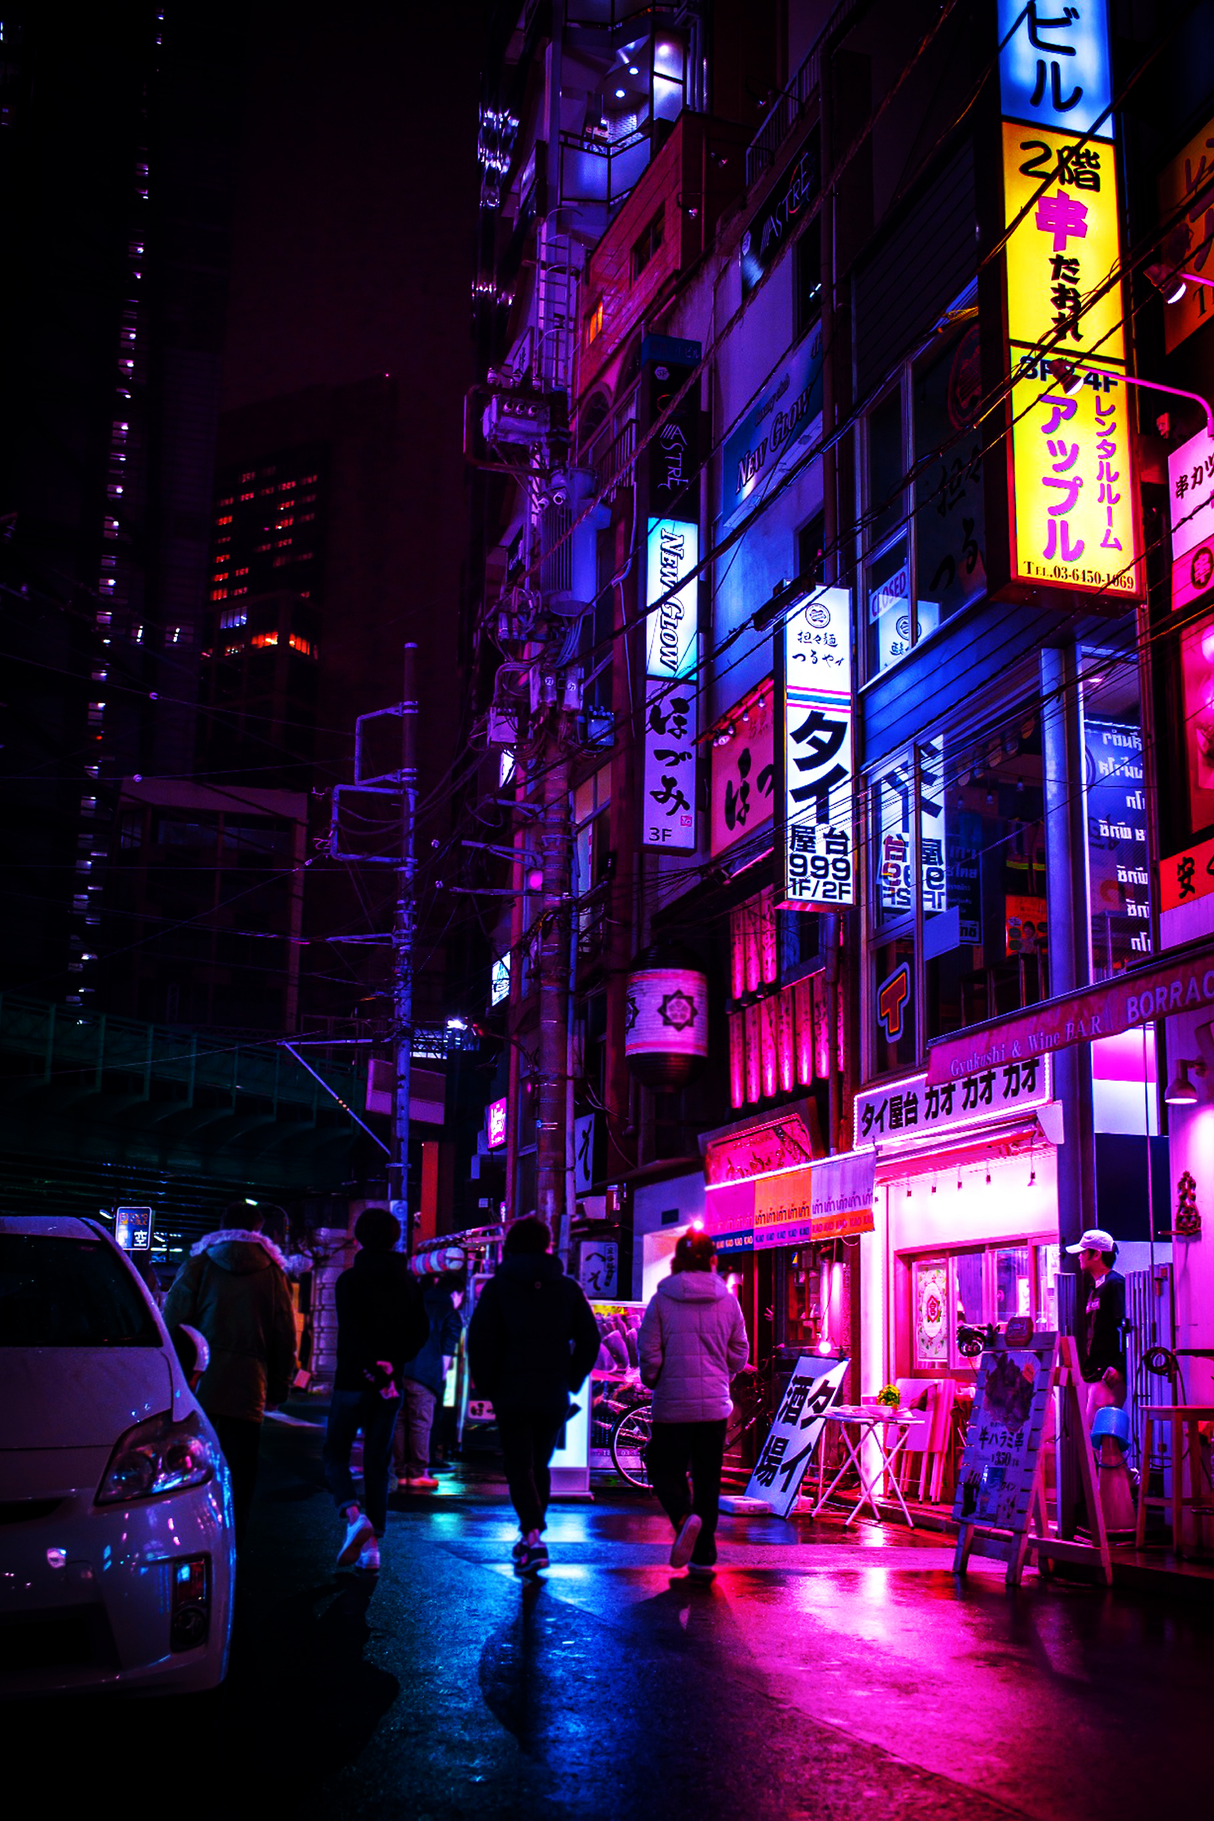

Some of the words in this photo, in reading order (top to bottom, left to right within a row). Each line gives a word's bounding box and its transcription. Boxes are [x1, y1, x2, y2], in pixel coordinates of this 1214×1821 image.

[1018, 141, 1101, 192] 2階
[1037, 394, 1085, 562] アップル
[1095, 395, 1123, 551] レンタルルーム
[871, 570, 906, 618] CLOSED
[789, 710, 849, 825] タイ
[648, 827, 672, 842] 3F
[789, 824, 850, 855] 屋台
[789, 854, 851, 881] 999
[789, 878, 851, 900] 1F/2F
[1028, 1031, 1060, 1053] Wine
[1065, 1015, 1102, 1042] BAR
[861, 1091, 919, 1137] タイ屋台
[754, 1375, 816, 1488] 酒場
[780, 1379, 837, 1493] タイ
[978, 1426, 1024, 1452] 牛ハラミ串
